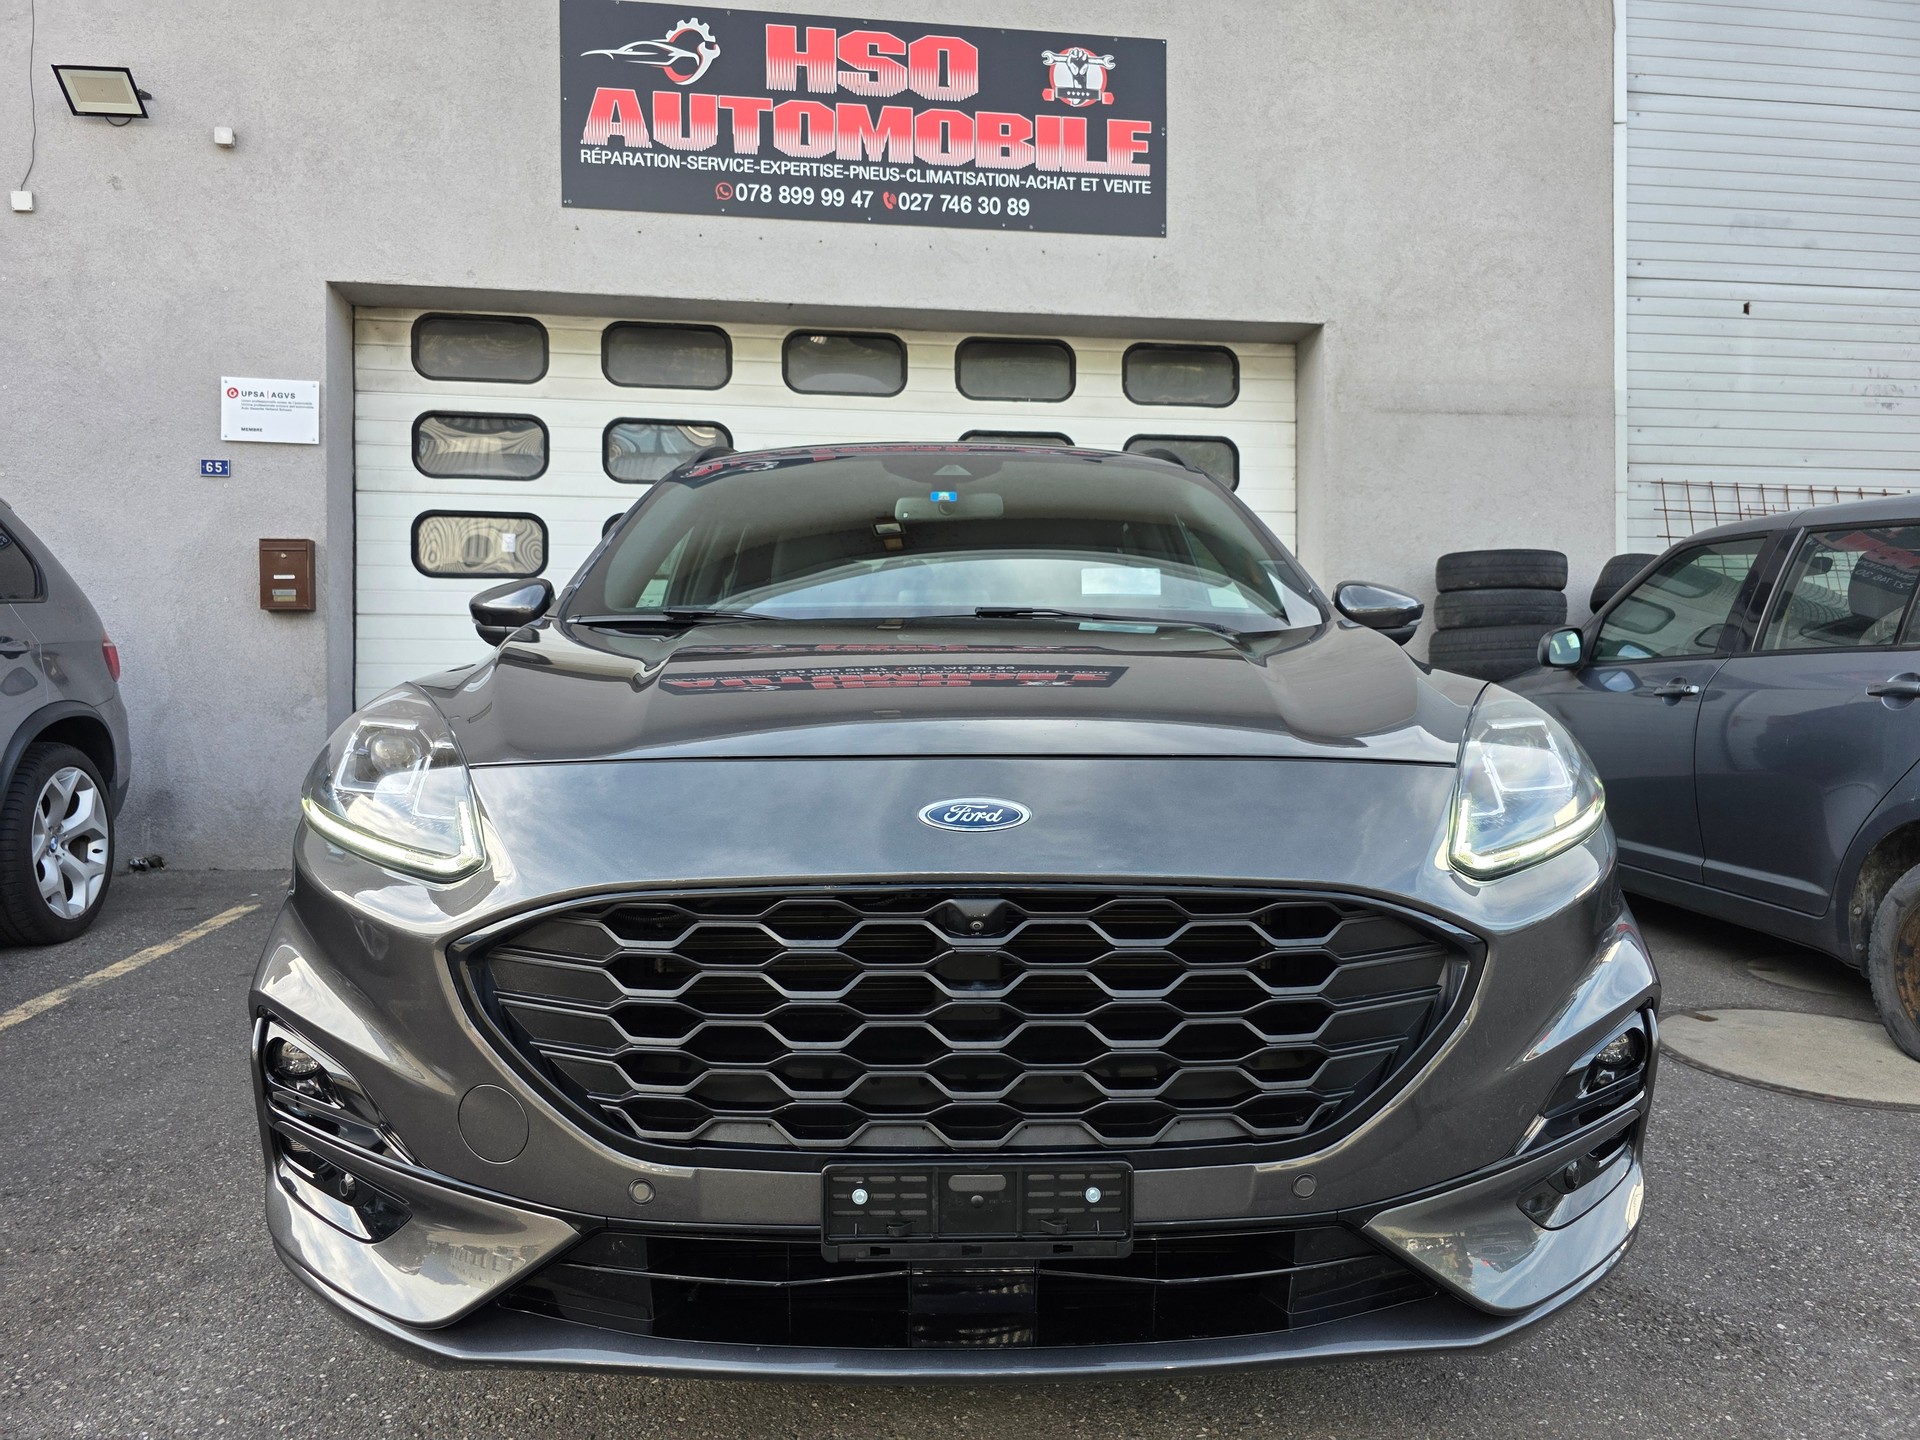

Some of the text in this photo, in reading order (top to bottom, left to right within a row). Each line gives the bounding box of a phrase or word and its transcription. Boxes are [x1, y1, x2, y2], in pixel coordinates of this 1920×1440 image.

[766, 23, 979, 102] HSO
[580, 87, 1152, 177] AUTOMOBILE
[735, 183, 874, 208] 078 899 99 47
[1081, 178, 1099, 192] ET
[1103, 179, 1152, 194] VENTE
[898, 192, 1030, 217] 027 746 30 89
[241, 390, 265, 398] UPSA
[205, 461, 223, 473] 65
[944, 804, 1004, 822] Ford
